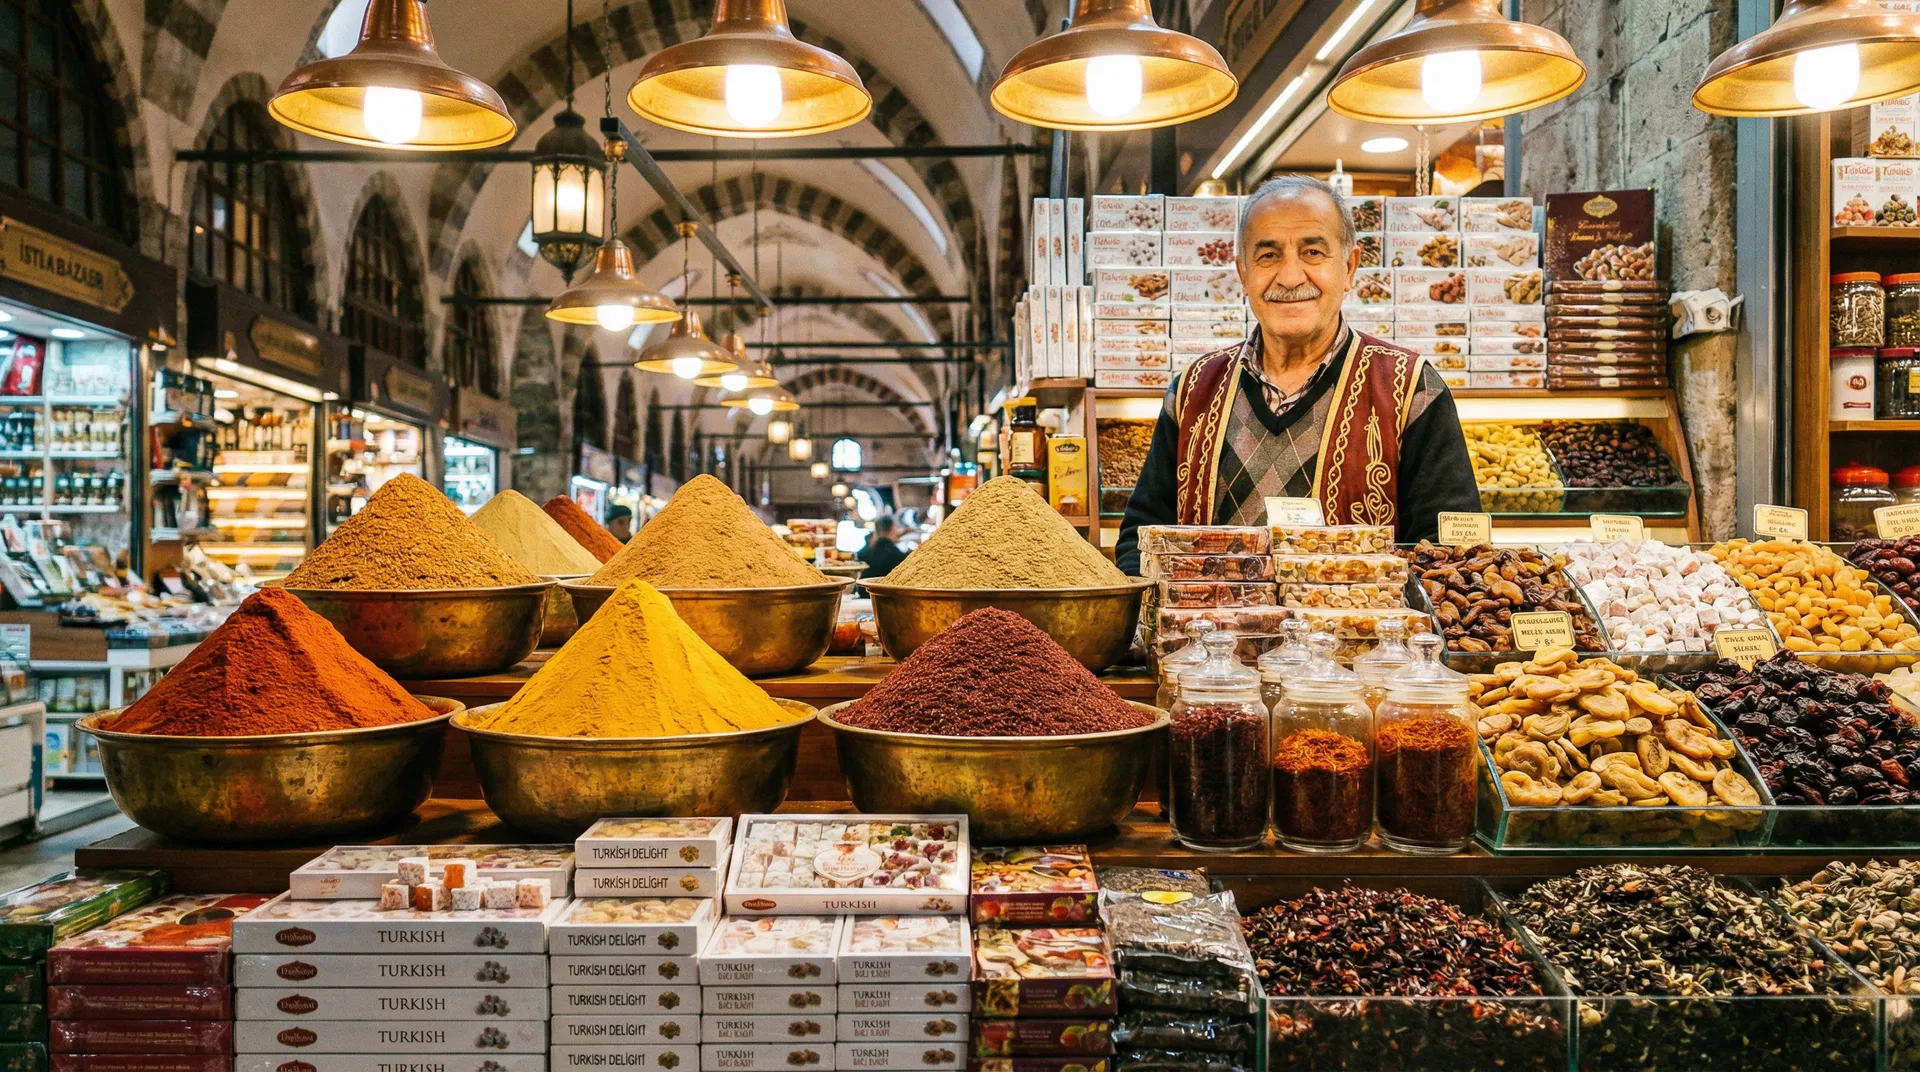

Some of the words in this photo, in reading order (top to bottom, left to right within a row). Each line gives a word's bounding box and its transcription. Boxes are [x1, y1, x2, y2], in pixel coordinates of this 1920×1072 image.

[377, 930, 445, 943] TURKISH
[377, 964, 445, 977] TURKISH
[377, 998, 445, 1010] TURKISH
[377, 1031, 445, 1043] TURKISH
